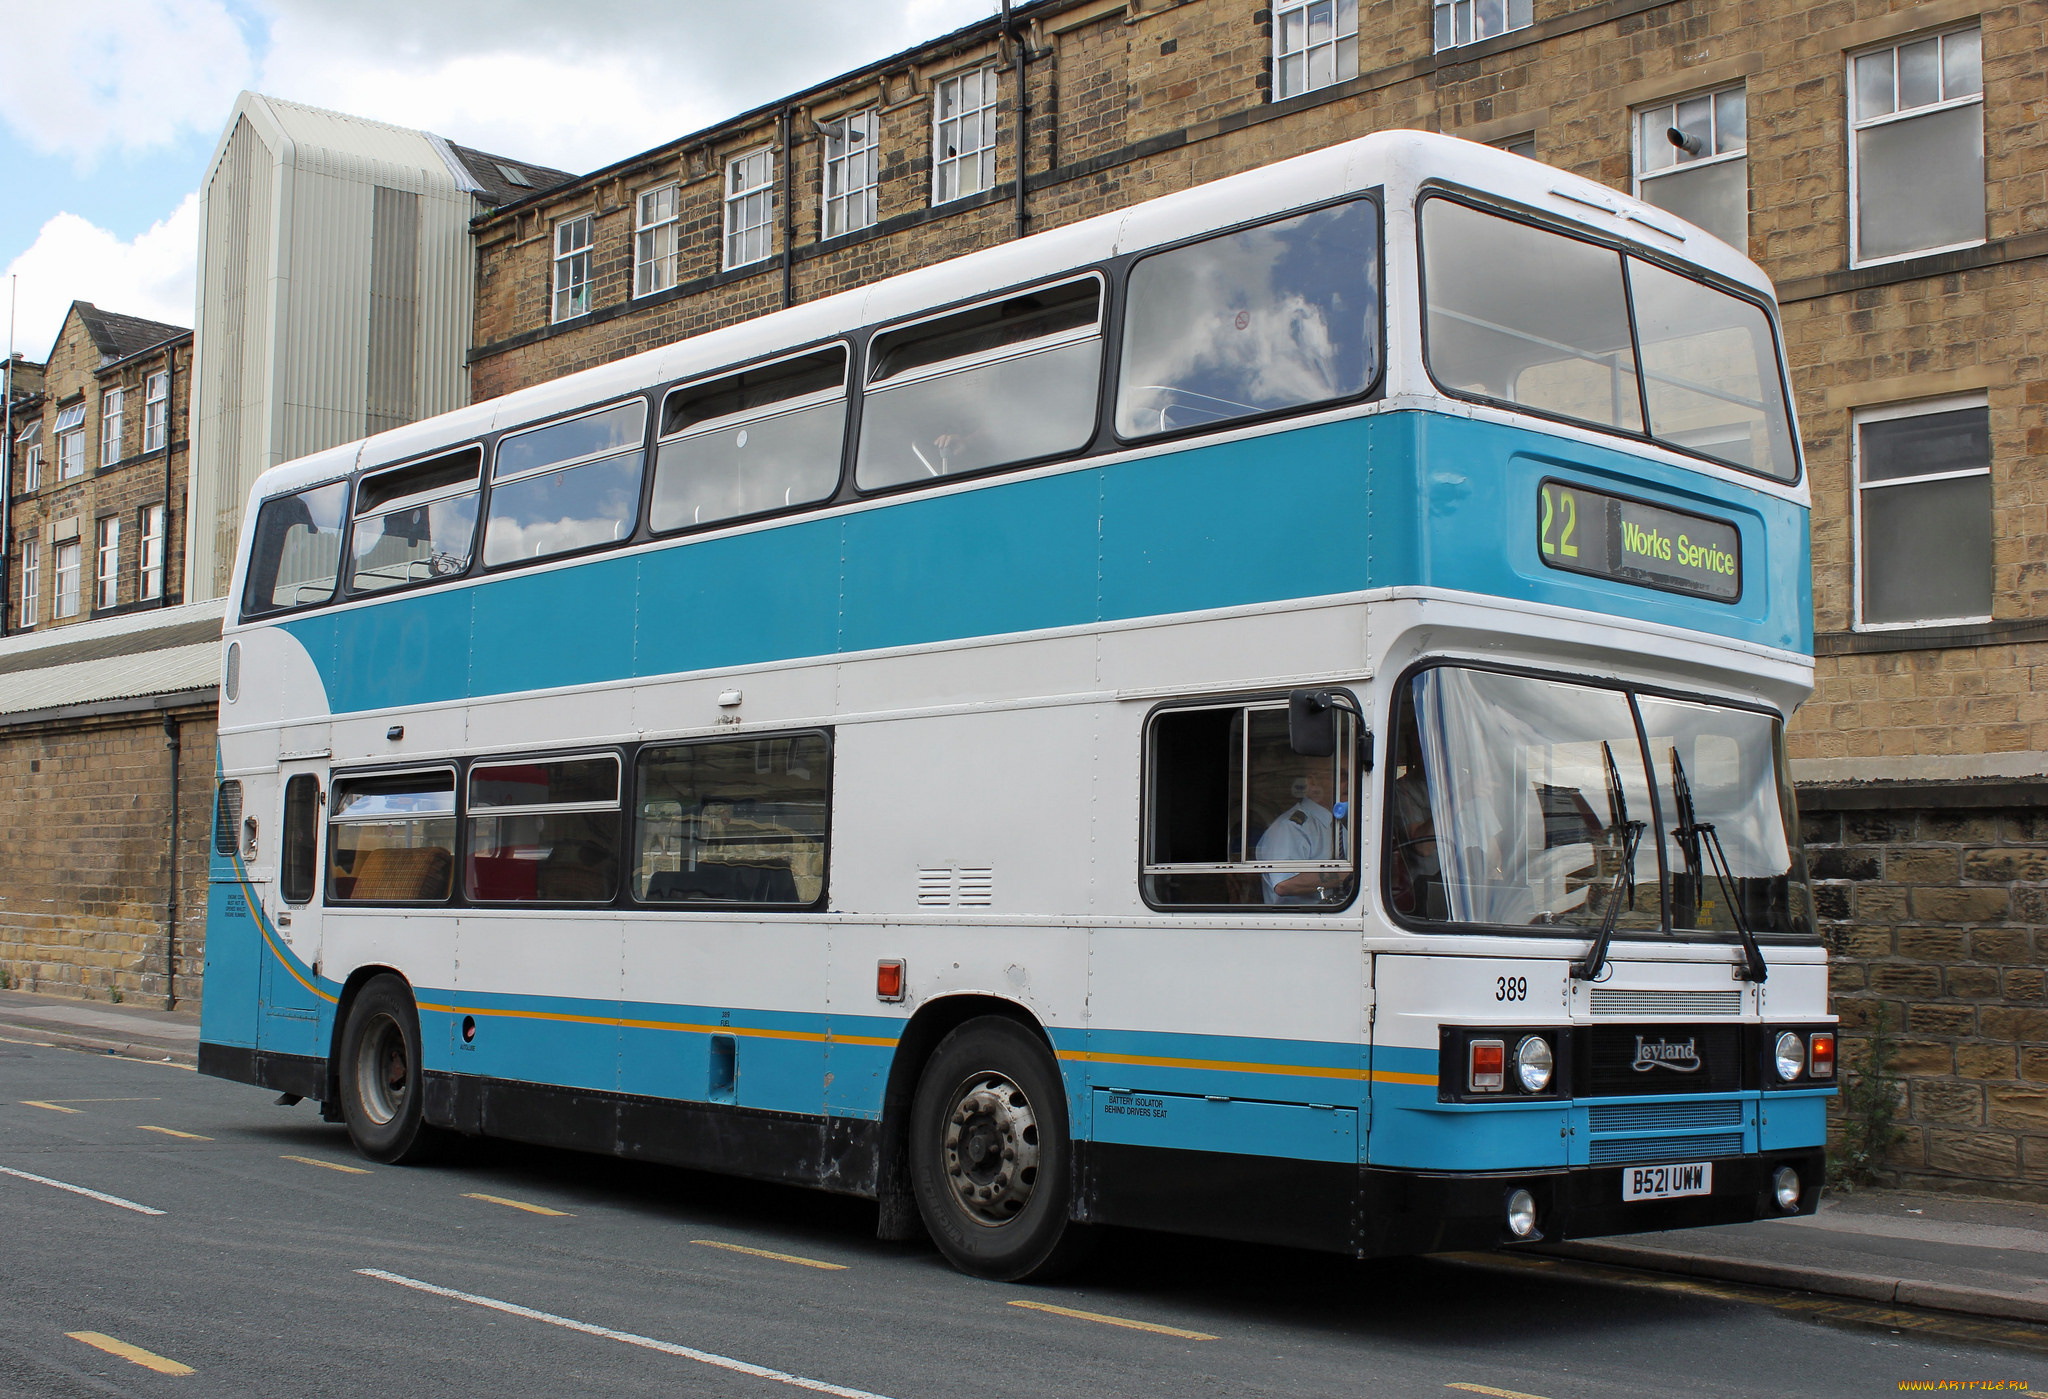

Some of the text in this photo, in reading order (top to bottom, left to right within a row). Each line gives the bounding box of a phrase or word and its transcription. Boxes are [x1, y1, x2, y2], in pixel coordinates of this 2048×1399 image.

[1541, 486, 1735, 576] 22 Works Service
[1495, 976, 1527, 1001] 389
[1631, 1034, 1700, 1072] Leyland
[1104, 1105, 1168, 1118] BEHIND DRIVERS SEAT
[1109, 1096, 1163, 1108] BATTERY ISOLATOR
[1633, 1165, 1703, 1194] B521 UWW
